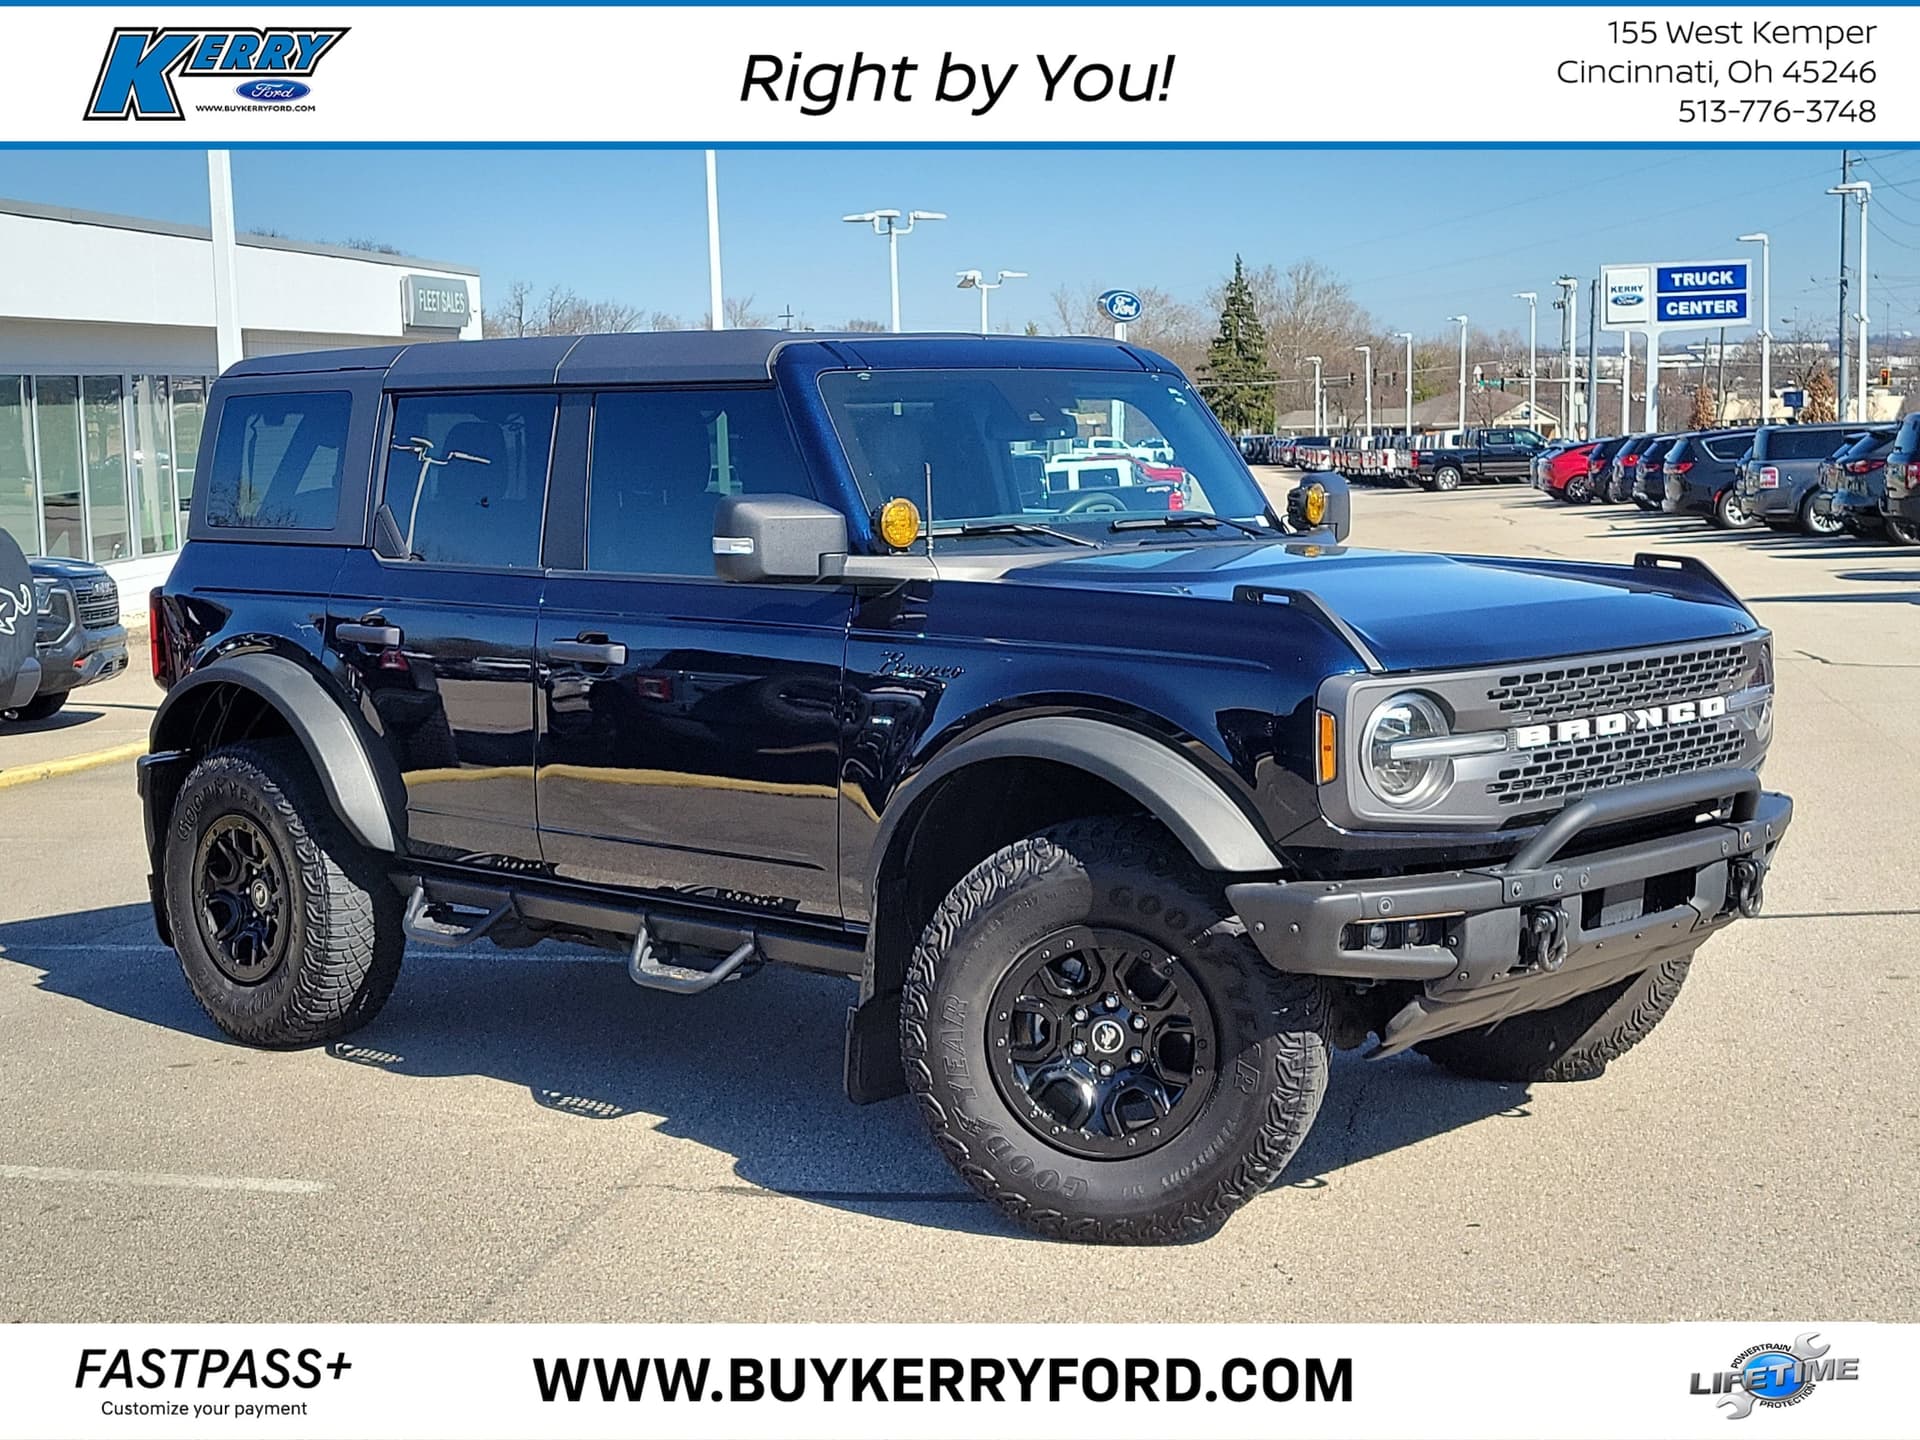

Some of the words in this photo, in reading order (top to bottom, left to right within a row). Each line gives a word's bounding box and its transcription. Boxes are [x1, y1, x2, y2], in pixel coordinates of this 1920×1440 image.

[1671, 271, 1734, 287] TRUCK
[1610, 284, 1644, 294] KERRY
[418, 289, 440, 312] FLEET
[441, 290, 465, 313] SALES
[1666, 299, 1738, 316] CENTER
[1515, 696, 1726, 749] BRONCO
